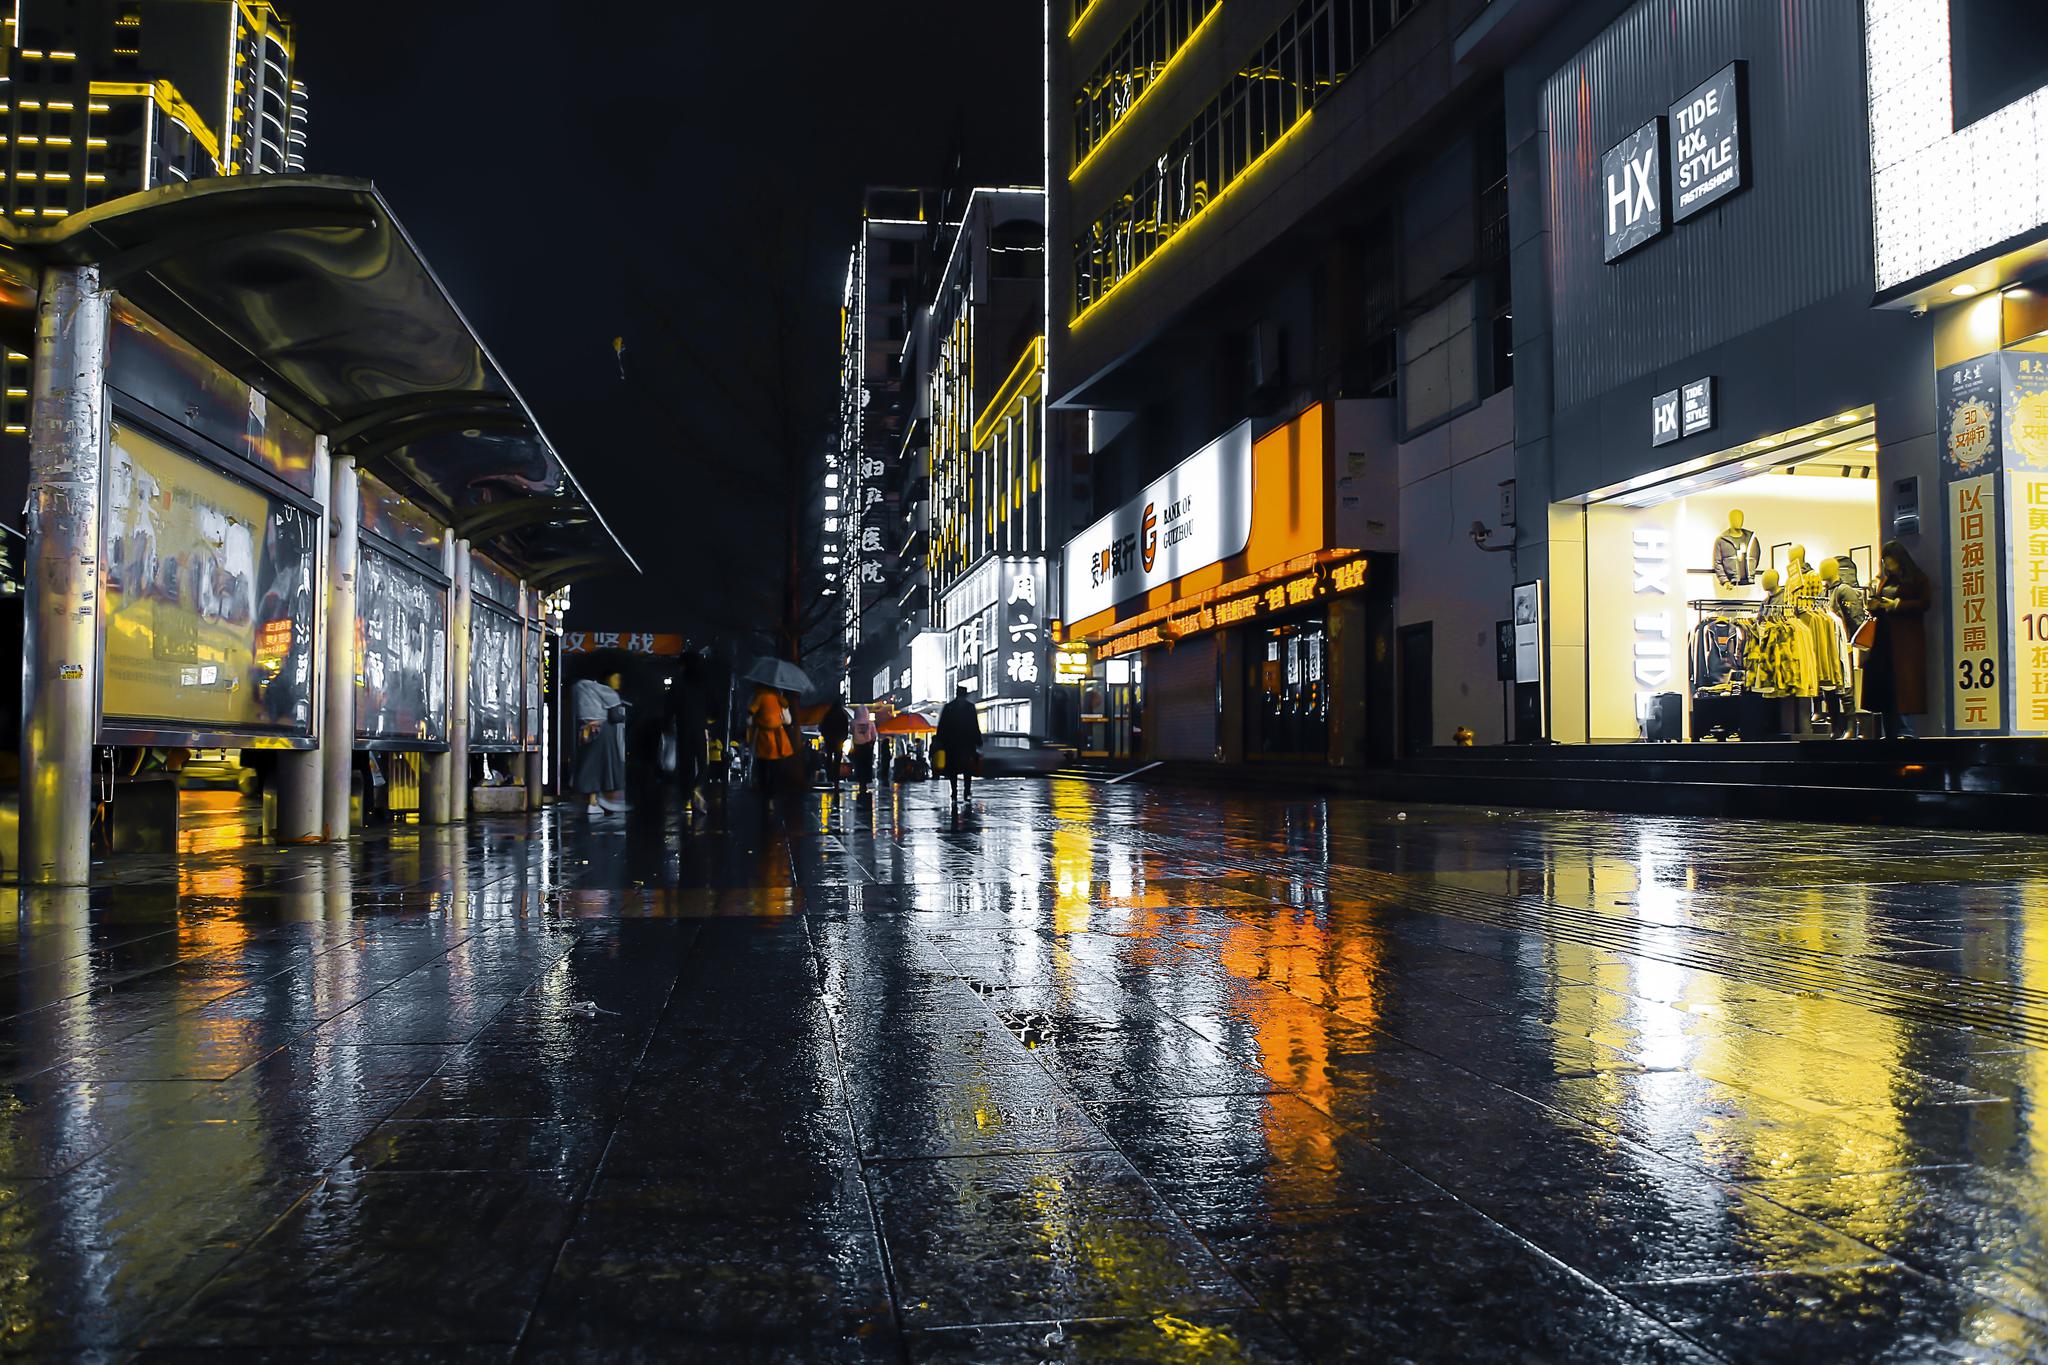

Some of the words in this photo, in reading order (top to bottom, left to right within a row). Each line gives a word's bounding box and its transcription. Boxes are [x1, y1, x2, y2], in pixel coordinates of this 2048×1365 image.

[1676, 88, 1718, 133] TIDE
[1677, 129, 1707, 163] HX&
[1679, 137, 1732, 188] STYLE
[1607, 148, 1656, 236] HX
[1953, 364, 1981, 385] 周大生
[2019, 359, 2048, 373] 周大
[1685, 384, 1704, 400] TIDE
[1654, 400, 1677, 436] HX
[1685, 406, 1708, 423] STYLE
[1955, 425, 1985, 448] 女神节
[1163, 501, 1181, 525] BANK
[1163, 518, 1194, 549] GUIZHOU
[1091, 532, 1137, 589] 贵州银行
[1633, 528, 1670, 595] HX
[1007, 574, 1038, 683] 周六福
